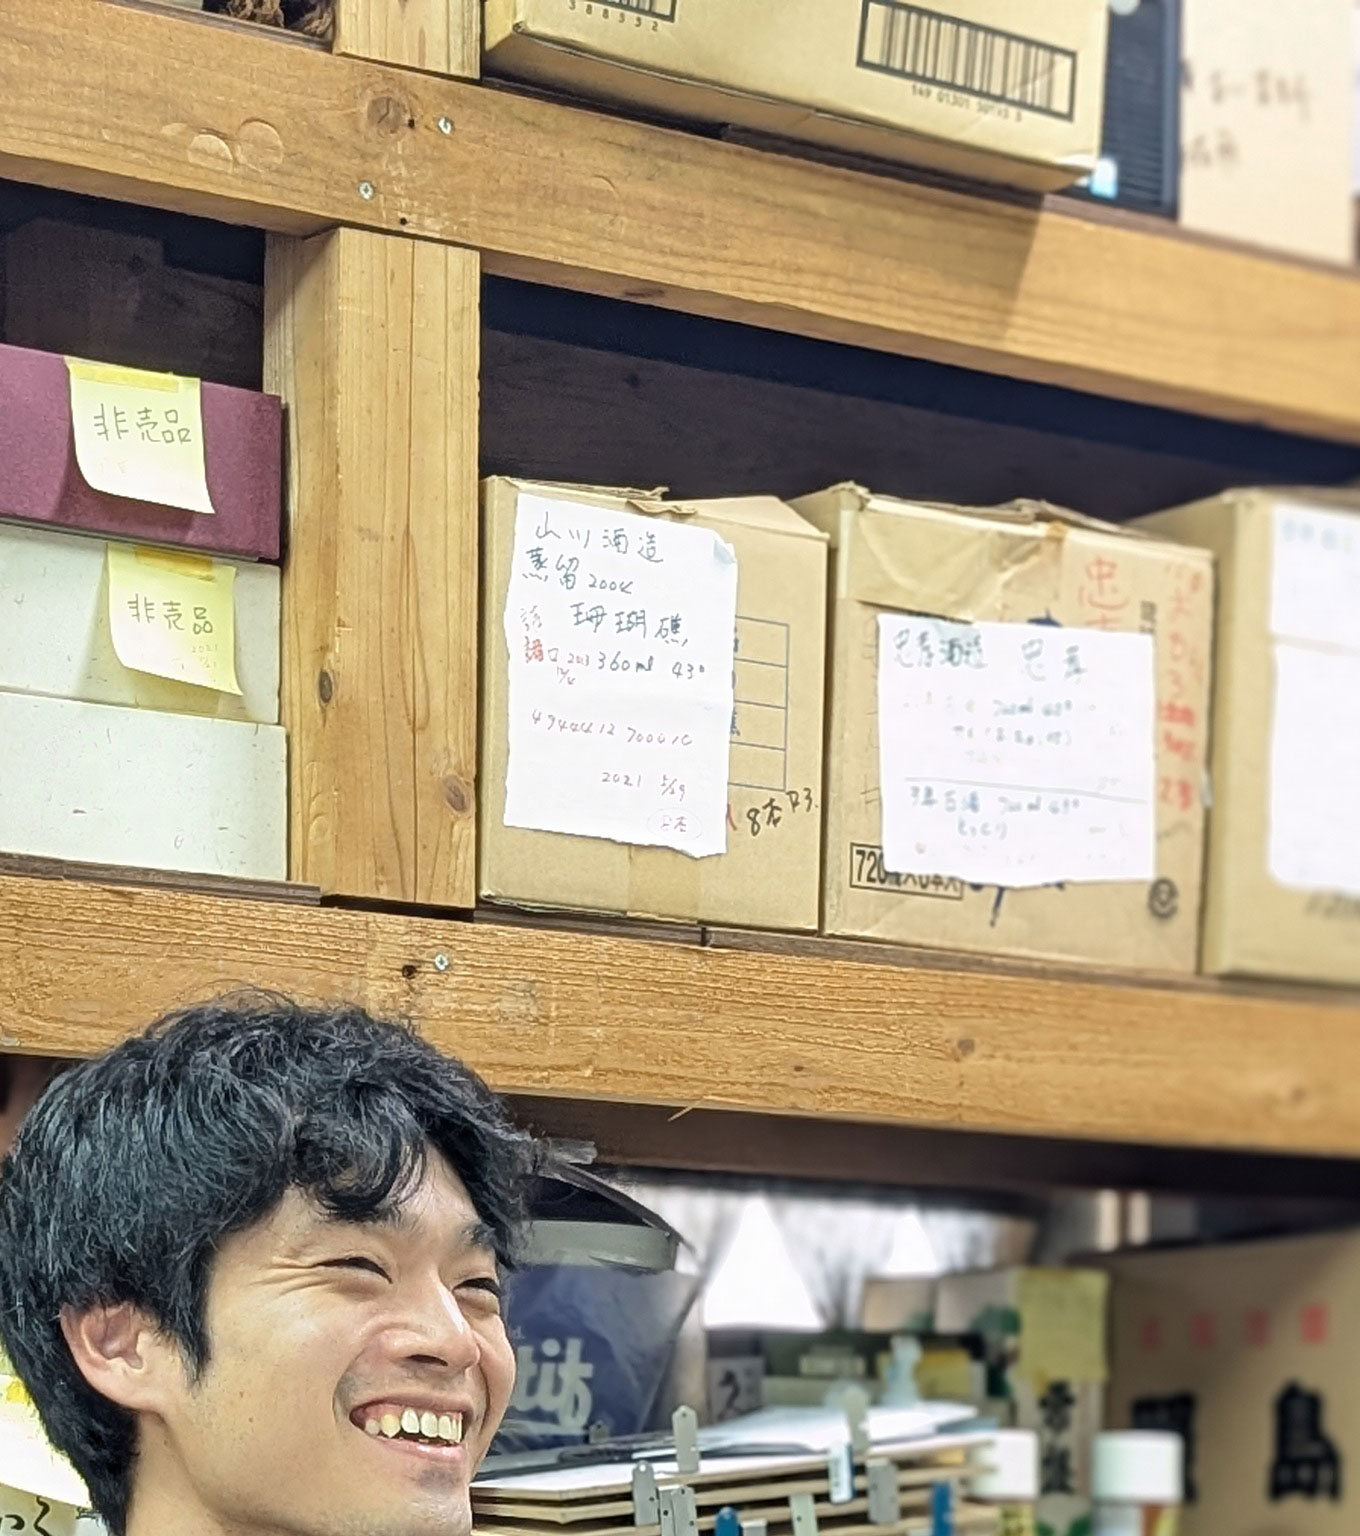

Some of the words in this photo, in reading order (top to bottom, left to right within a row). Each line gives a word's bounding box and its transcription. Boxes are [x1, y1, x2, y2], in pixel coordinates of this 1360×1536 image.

[93, 402, 192, 443] 非売品
[127, 593, 214, 635] 非売品
